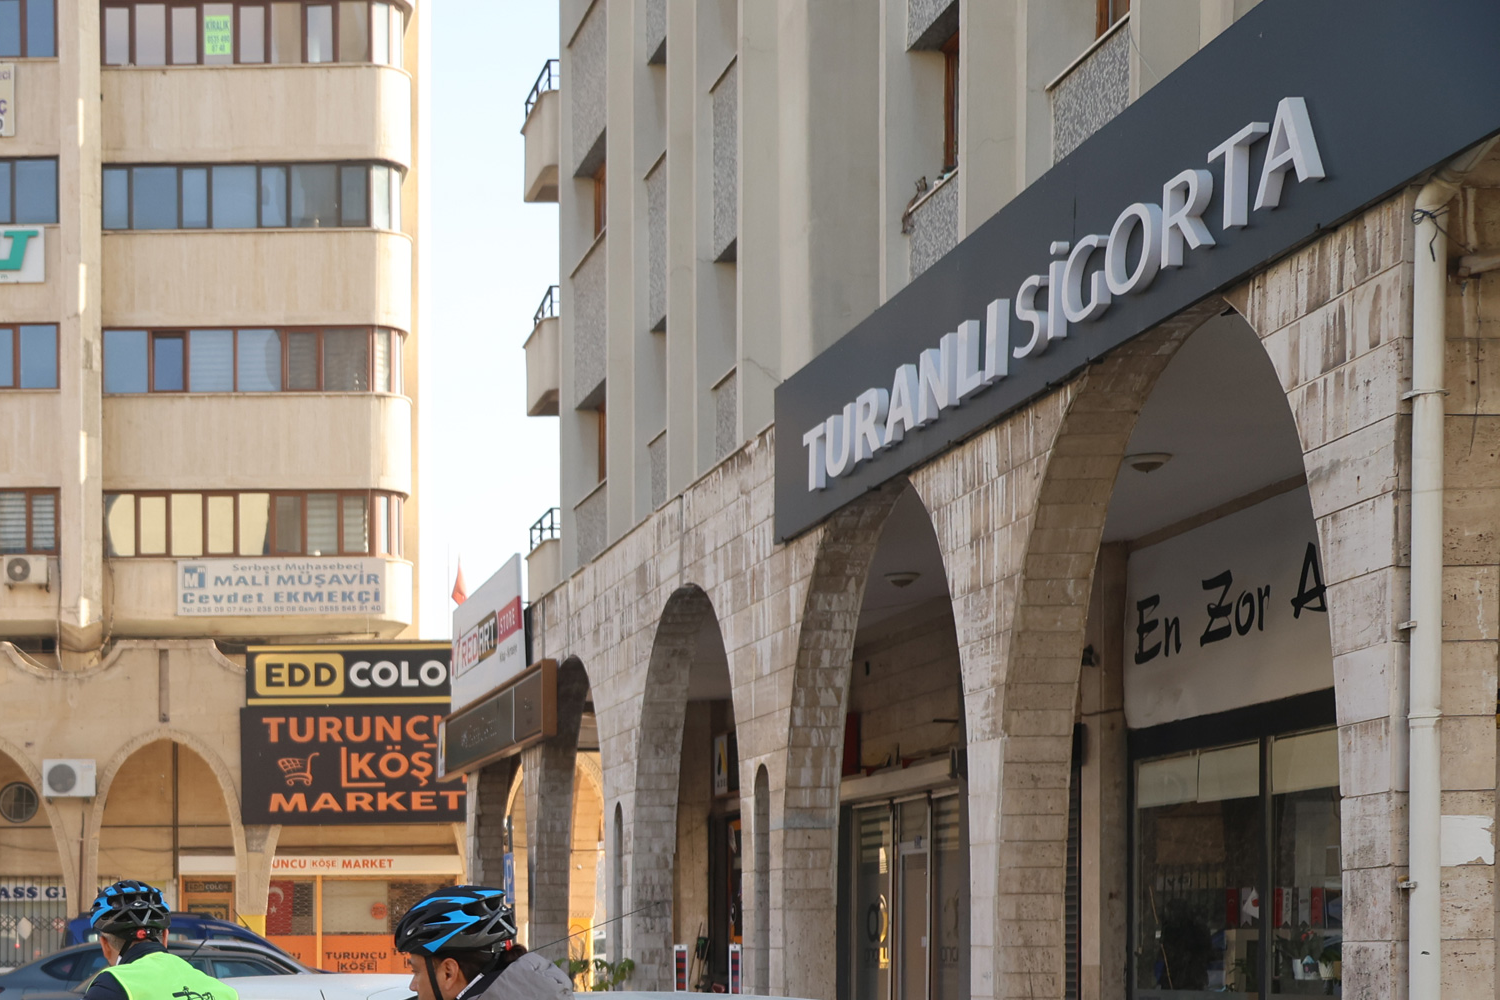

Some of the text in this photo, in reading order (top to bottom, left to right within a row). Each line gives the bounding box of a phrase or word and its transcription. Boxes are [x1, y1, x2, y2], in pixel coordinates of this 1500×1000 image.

[803, 97, 1326, 493] TURANLI SİGORTA
[285, 562, 363, 571] Muhasebeci
[214, 570, 380, 588] MALİ MÜŞAVİR
[183, 588, 380, 604] Cevdet EKMEKÇİ
[1135, 594, 1182, 665] En
[1200, 569, 1271, 647] Zor
[265, 660, 451, 688] EDD COLO
[350, 745, 434, 787] KÖŞ
[269, 790, 466, 813] MARKET
[272, 859, 307, 869] UNCU
[342, 858, 393, 869] MARKET
[325, 951, 387, 960] TURUNCU
